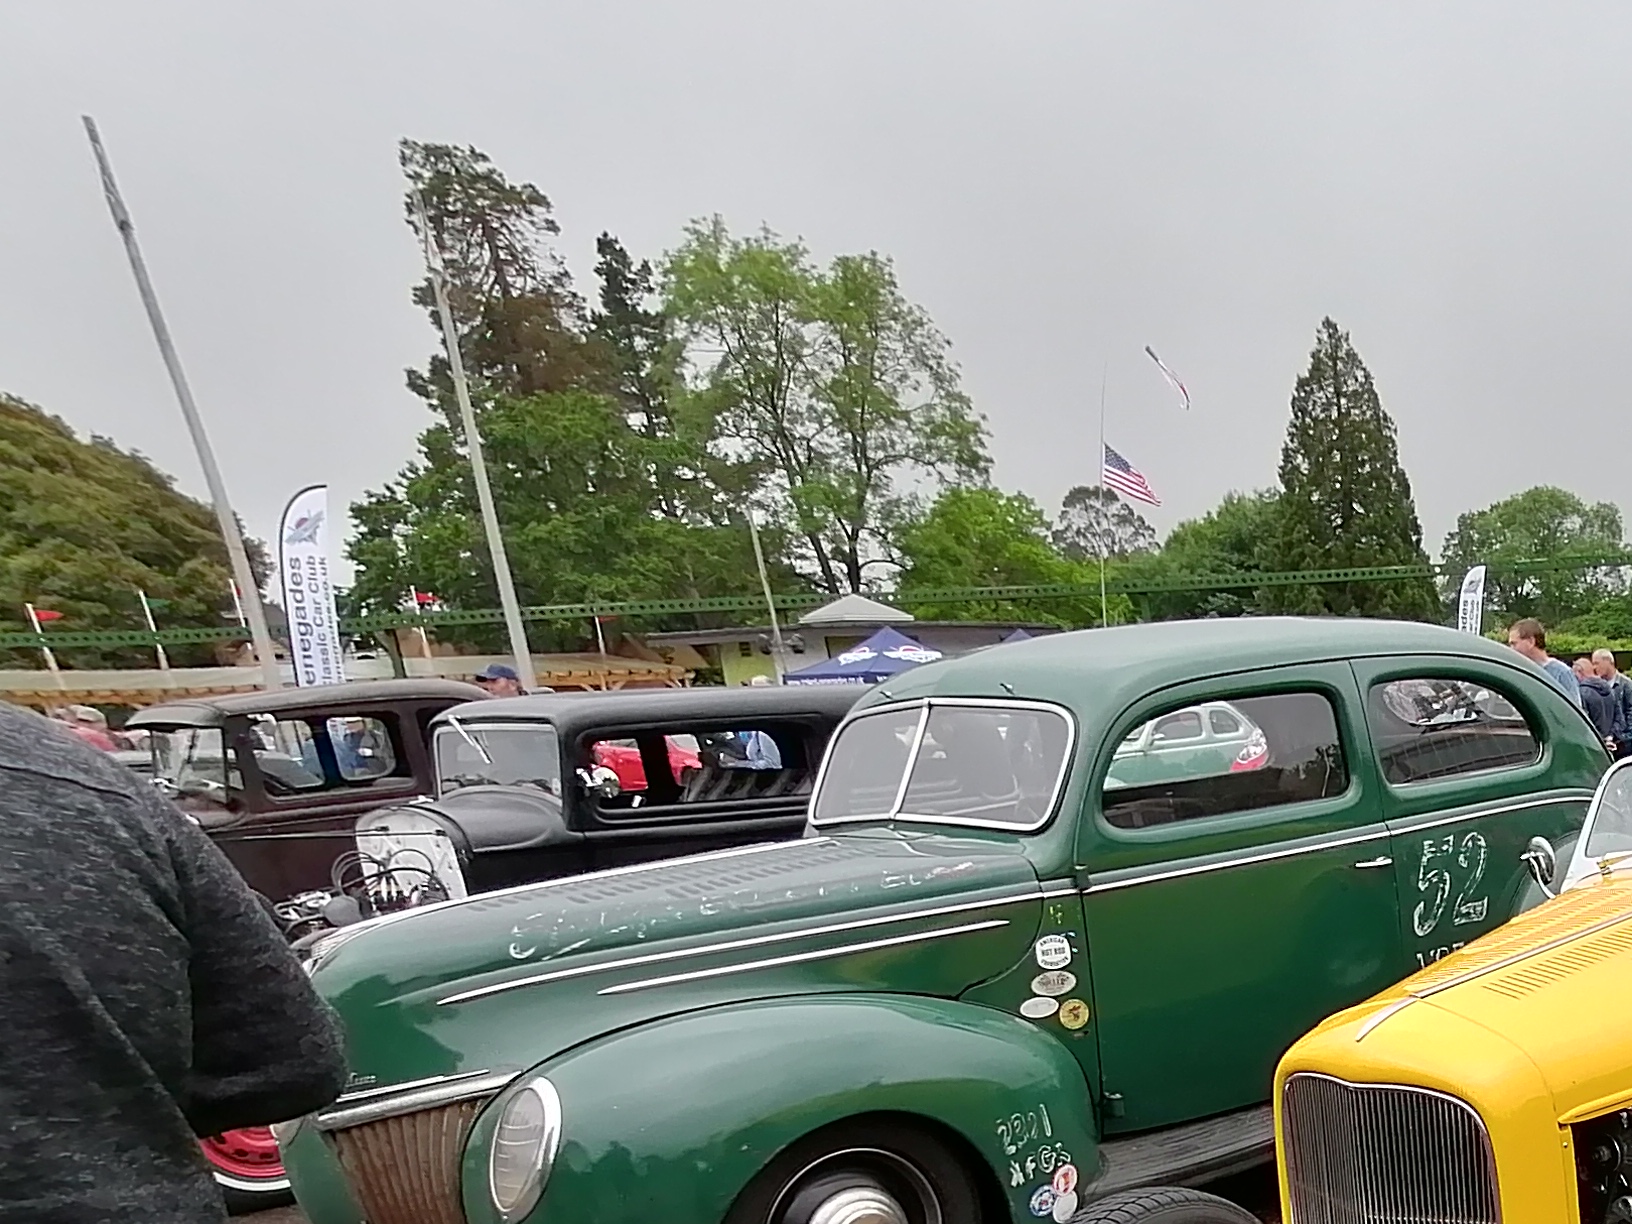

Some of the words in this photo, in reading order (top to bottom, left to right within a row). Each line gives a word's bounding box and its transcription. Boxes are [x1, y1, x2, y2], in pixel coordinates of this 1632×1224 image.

[306, 555, 320, 594] Club
[289, 557, 316, 685] enegades
[312, 599, 324, 628] Car
[1413, 832, 1489, 937] 52
